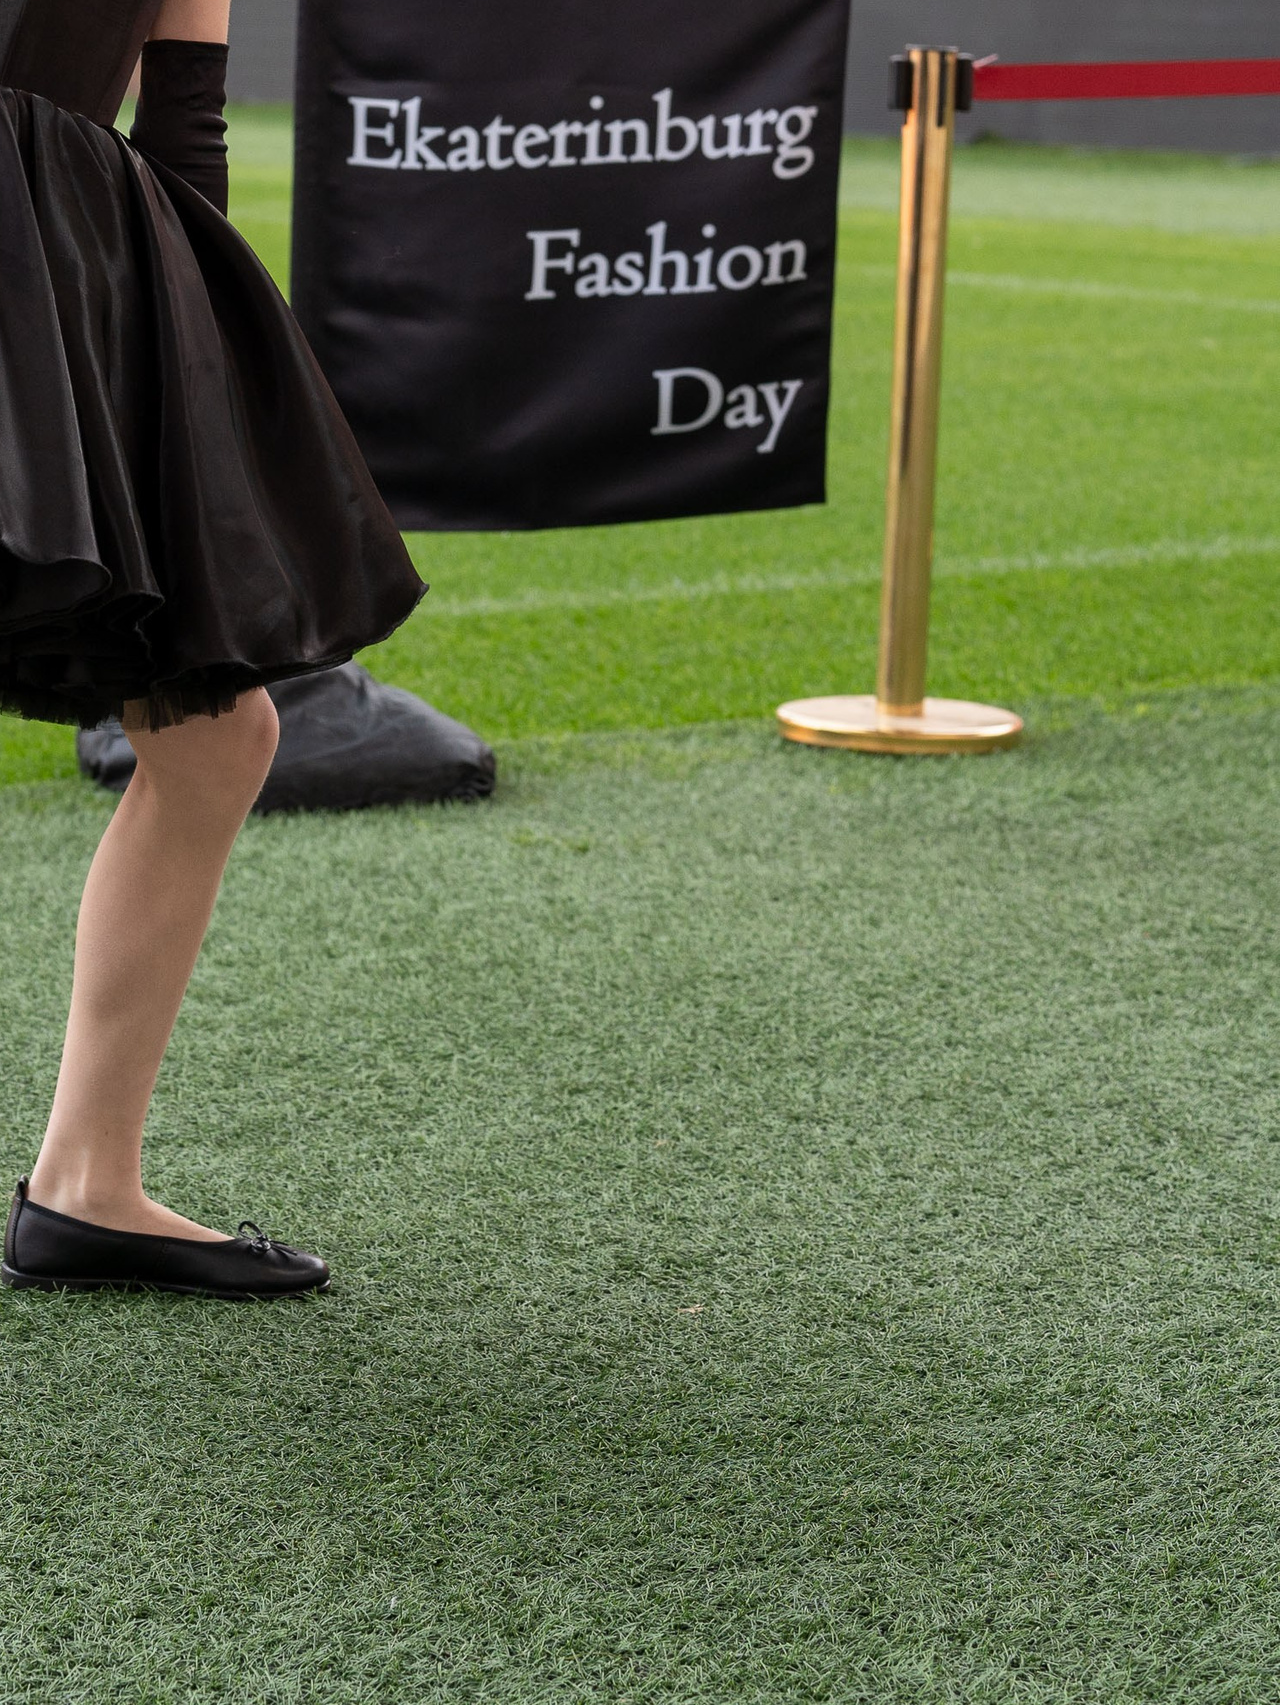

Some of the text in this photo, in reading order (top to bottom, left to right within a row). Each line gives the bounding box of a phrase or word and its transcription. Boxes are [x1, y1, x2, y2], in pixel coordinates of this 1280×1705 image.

[347, 87, 818, 179] Ekaterinburg
[525, 221, 807, 300] Fashion
[651, 367, 803, 453] Day
